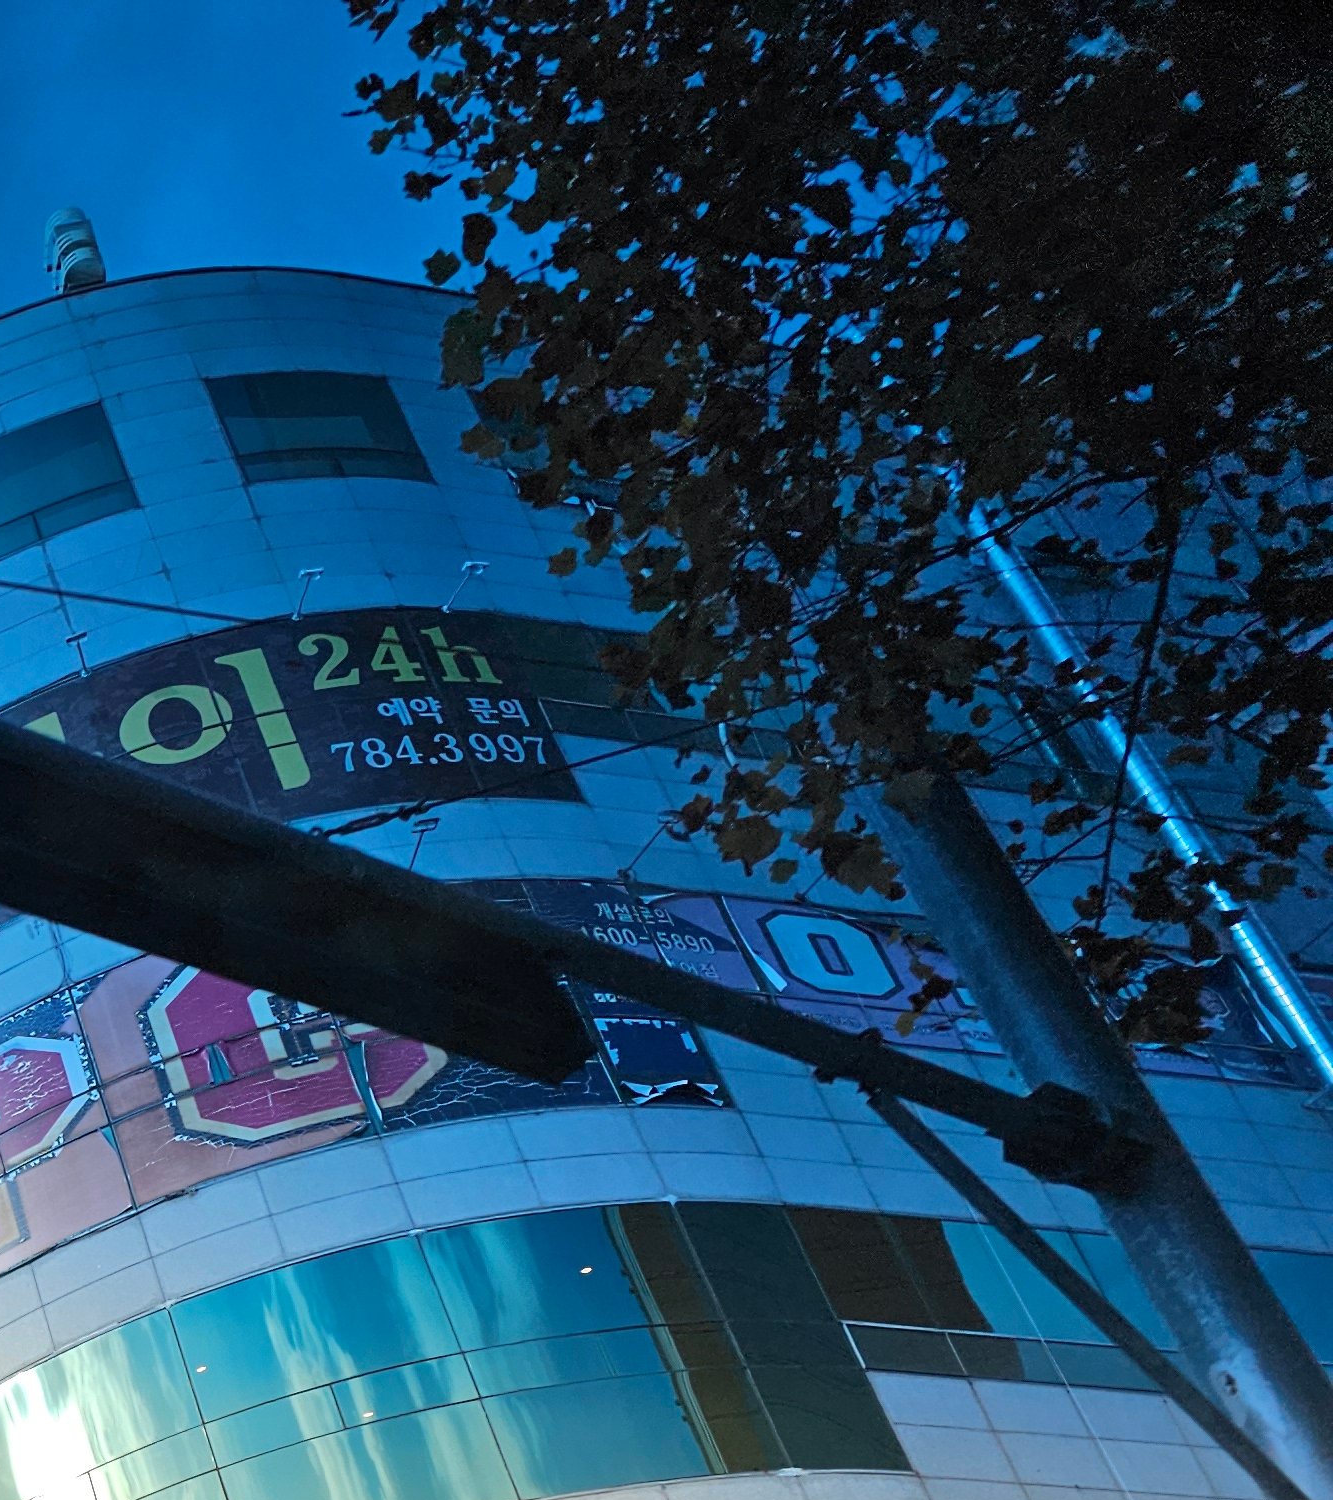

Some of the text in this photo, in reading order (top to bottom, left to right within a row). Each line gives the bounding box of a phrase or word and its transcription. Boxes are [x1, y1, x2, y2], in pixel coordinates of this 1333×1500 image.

[297, 626, 503, 690] 24h
[377, 697, 530, 727] 예약 문의
[331, 733, 546, 772] 784.3997
